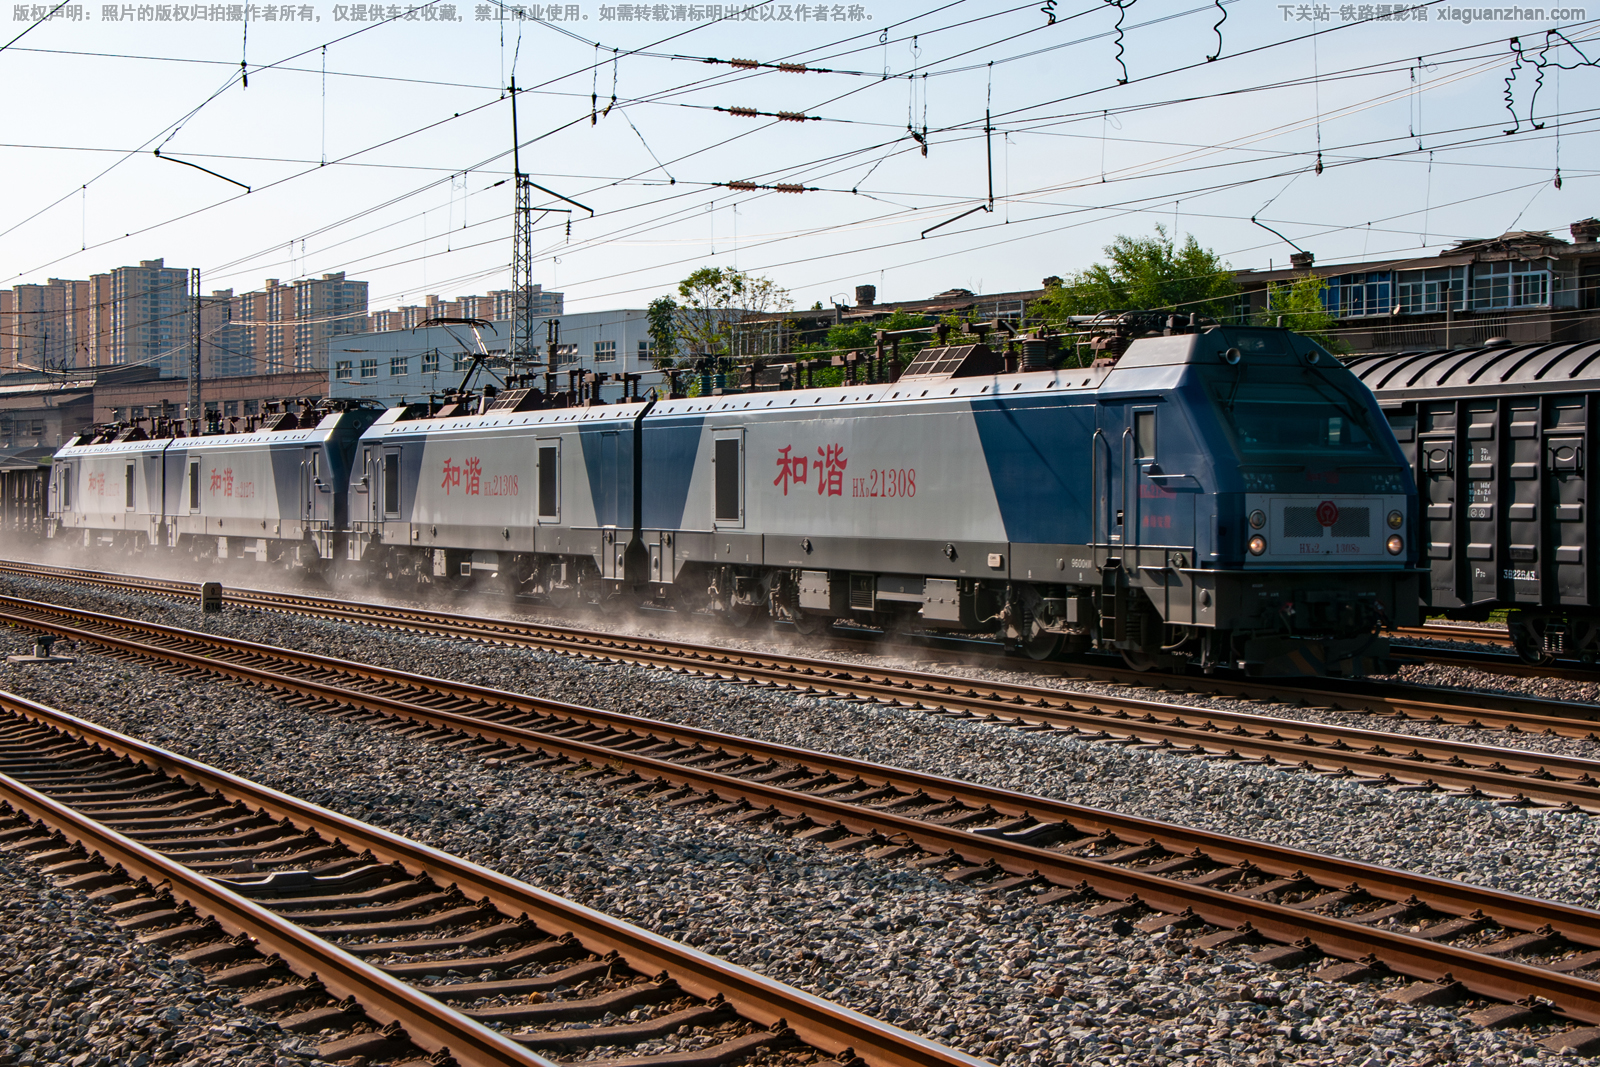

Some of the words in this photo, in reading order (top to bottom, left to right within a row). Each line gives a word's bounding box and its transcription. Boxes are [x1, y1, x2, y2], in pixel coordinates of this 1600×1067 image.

[209, 467, 234, 497] 和谐
[441, 456, 482, 496] 和谐
[773, 442, 848, 497] 和谐
